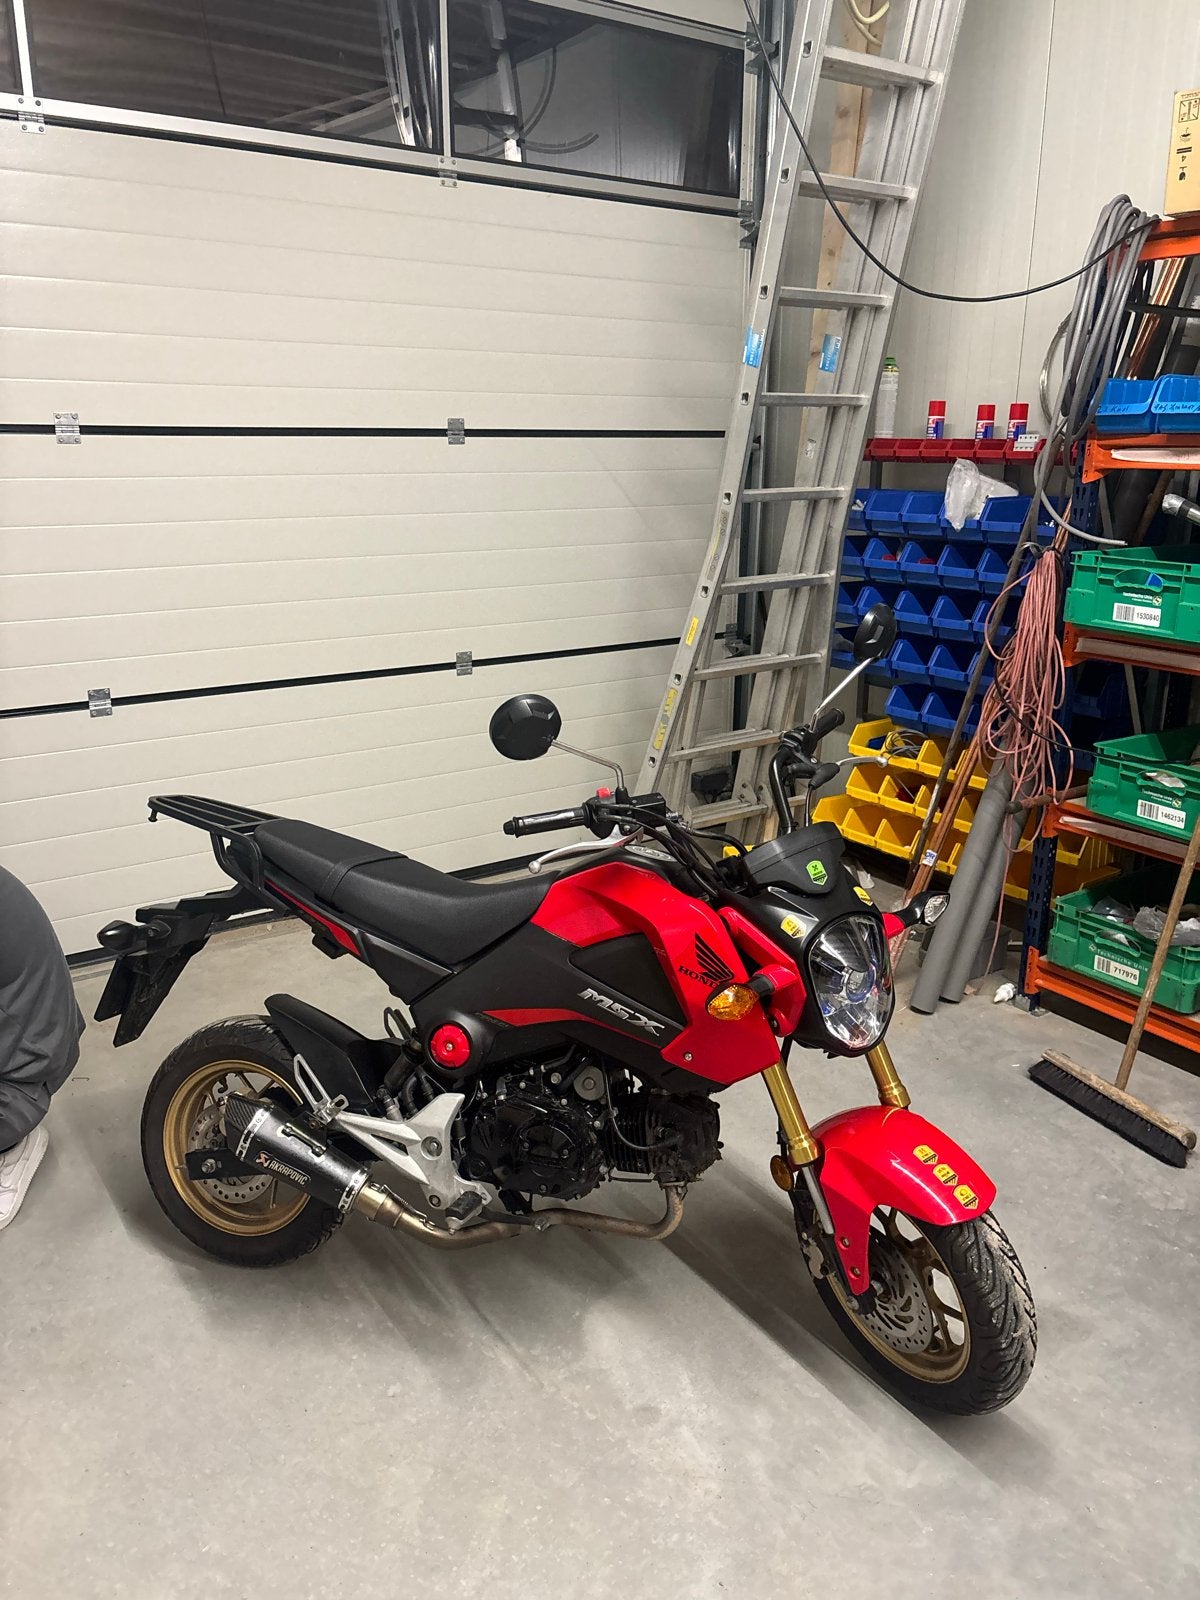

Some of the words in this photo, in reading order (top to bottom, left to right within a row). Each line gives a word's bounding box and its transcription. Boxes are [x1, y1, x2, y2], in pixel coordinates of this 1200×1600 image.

[1136, 612, 1160, 622] 1530840
[1161, 811, 1184, 823] 1462134
[1097, 949, 1132, 966] Technische
[1133, 962, 1149, 972] Unie
[677, 965, 719, 989] HOND
[577, 988, 665, 1037] MSX
